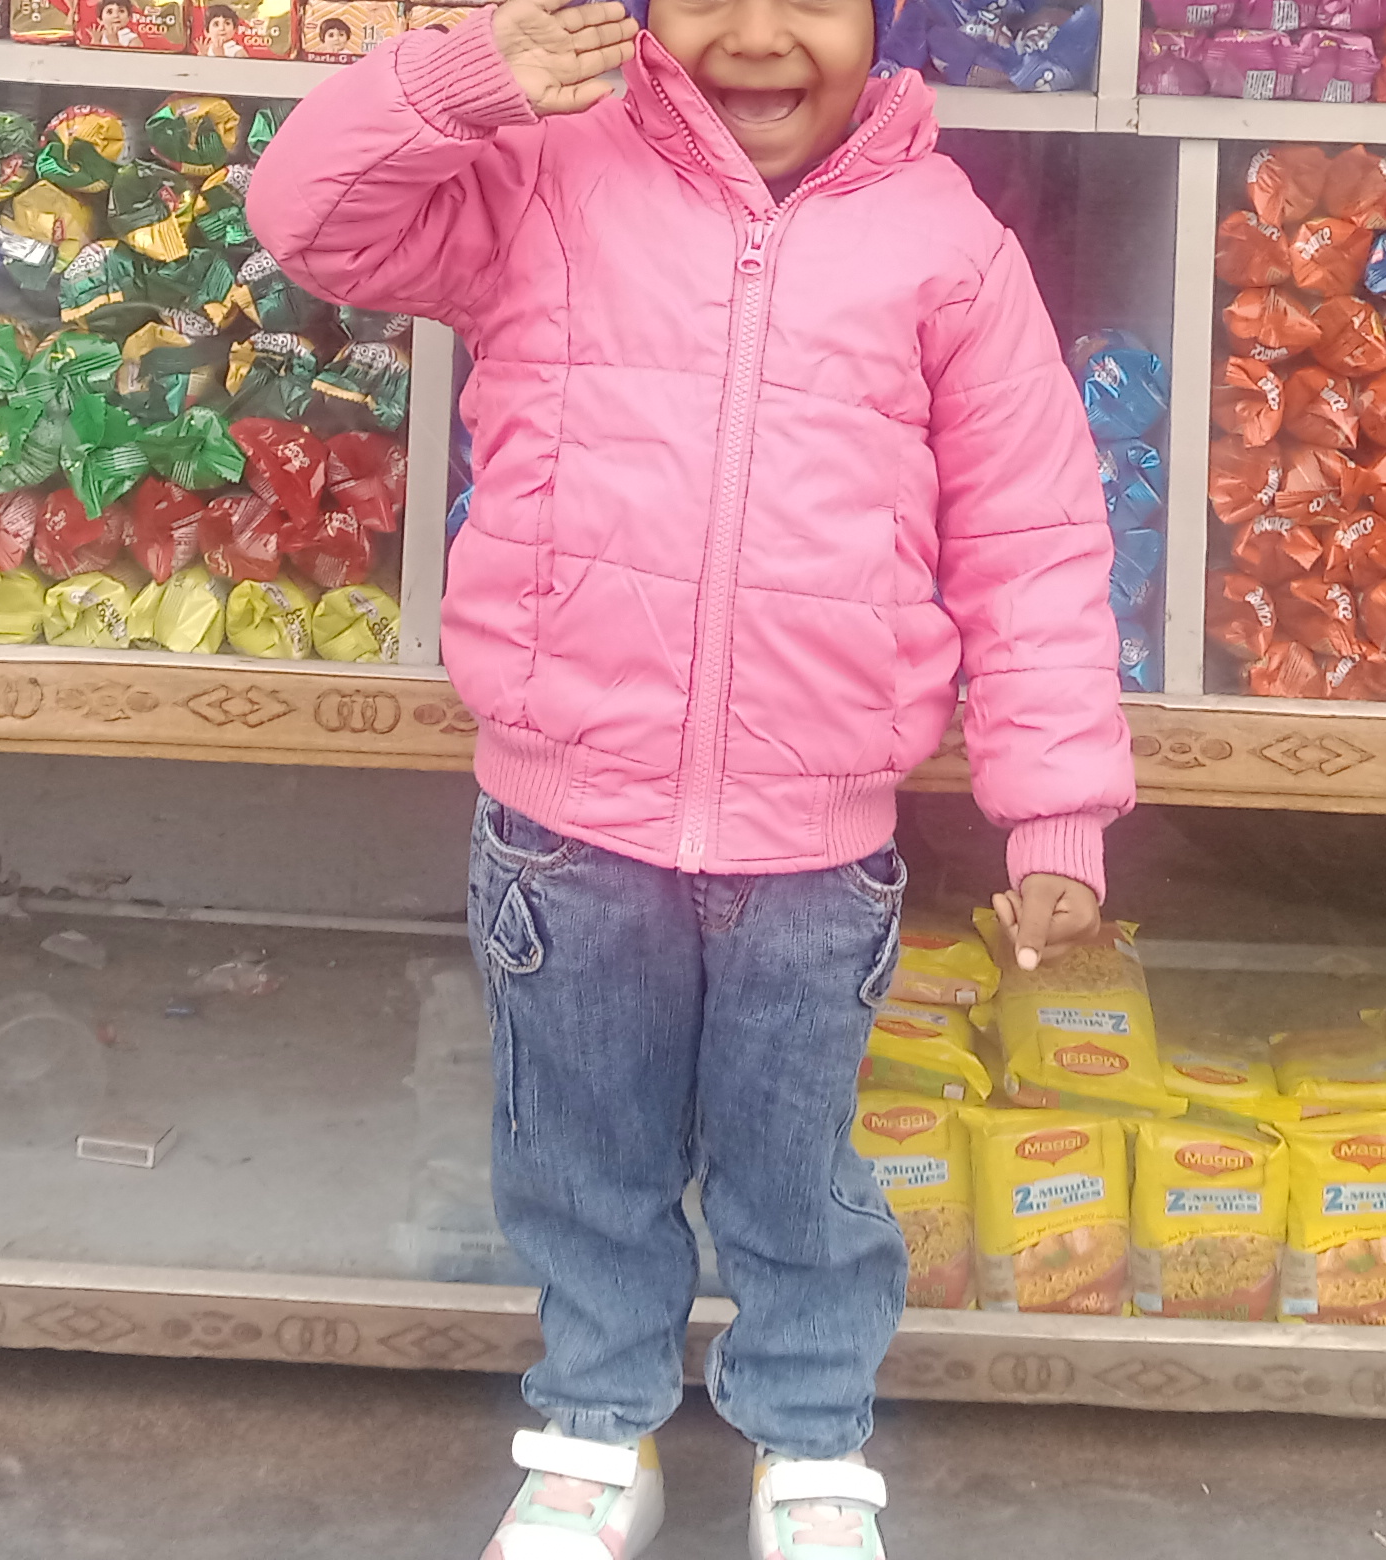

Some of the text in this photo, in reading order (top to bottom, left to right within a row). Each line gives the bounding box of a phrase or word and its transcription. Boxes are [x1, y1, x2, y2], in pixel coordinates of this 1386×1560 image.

[131, 13, 176, 26] Parle-G
[137, 24, 168, 35] GOLD
[243, 36, 272, 47] GOLD
[871, 1113, 931, 1129] Maggi
[1024, 1136, 1082, 1156] Maggi
[1183, 1151, 1245, 1170] Maggi
